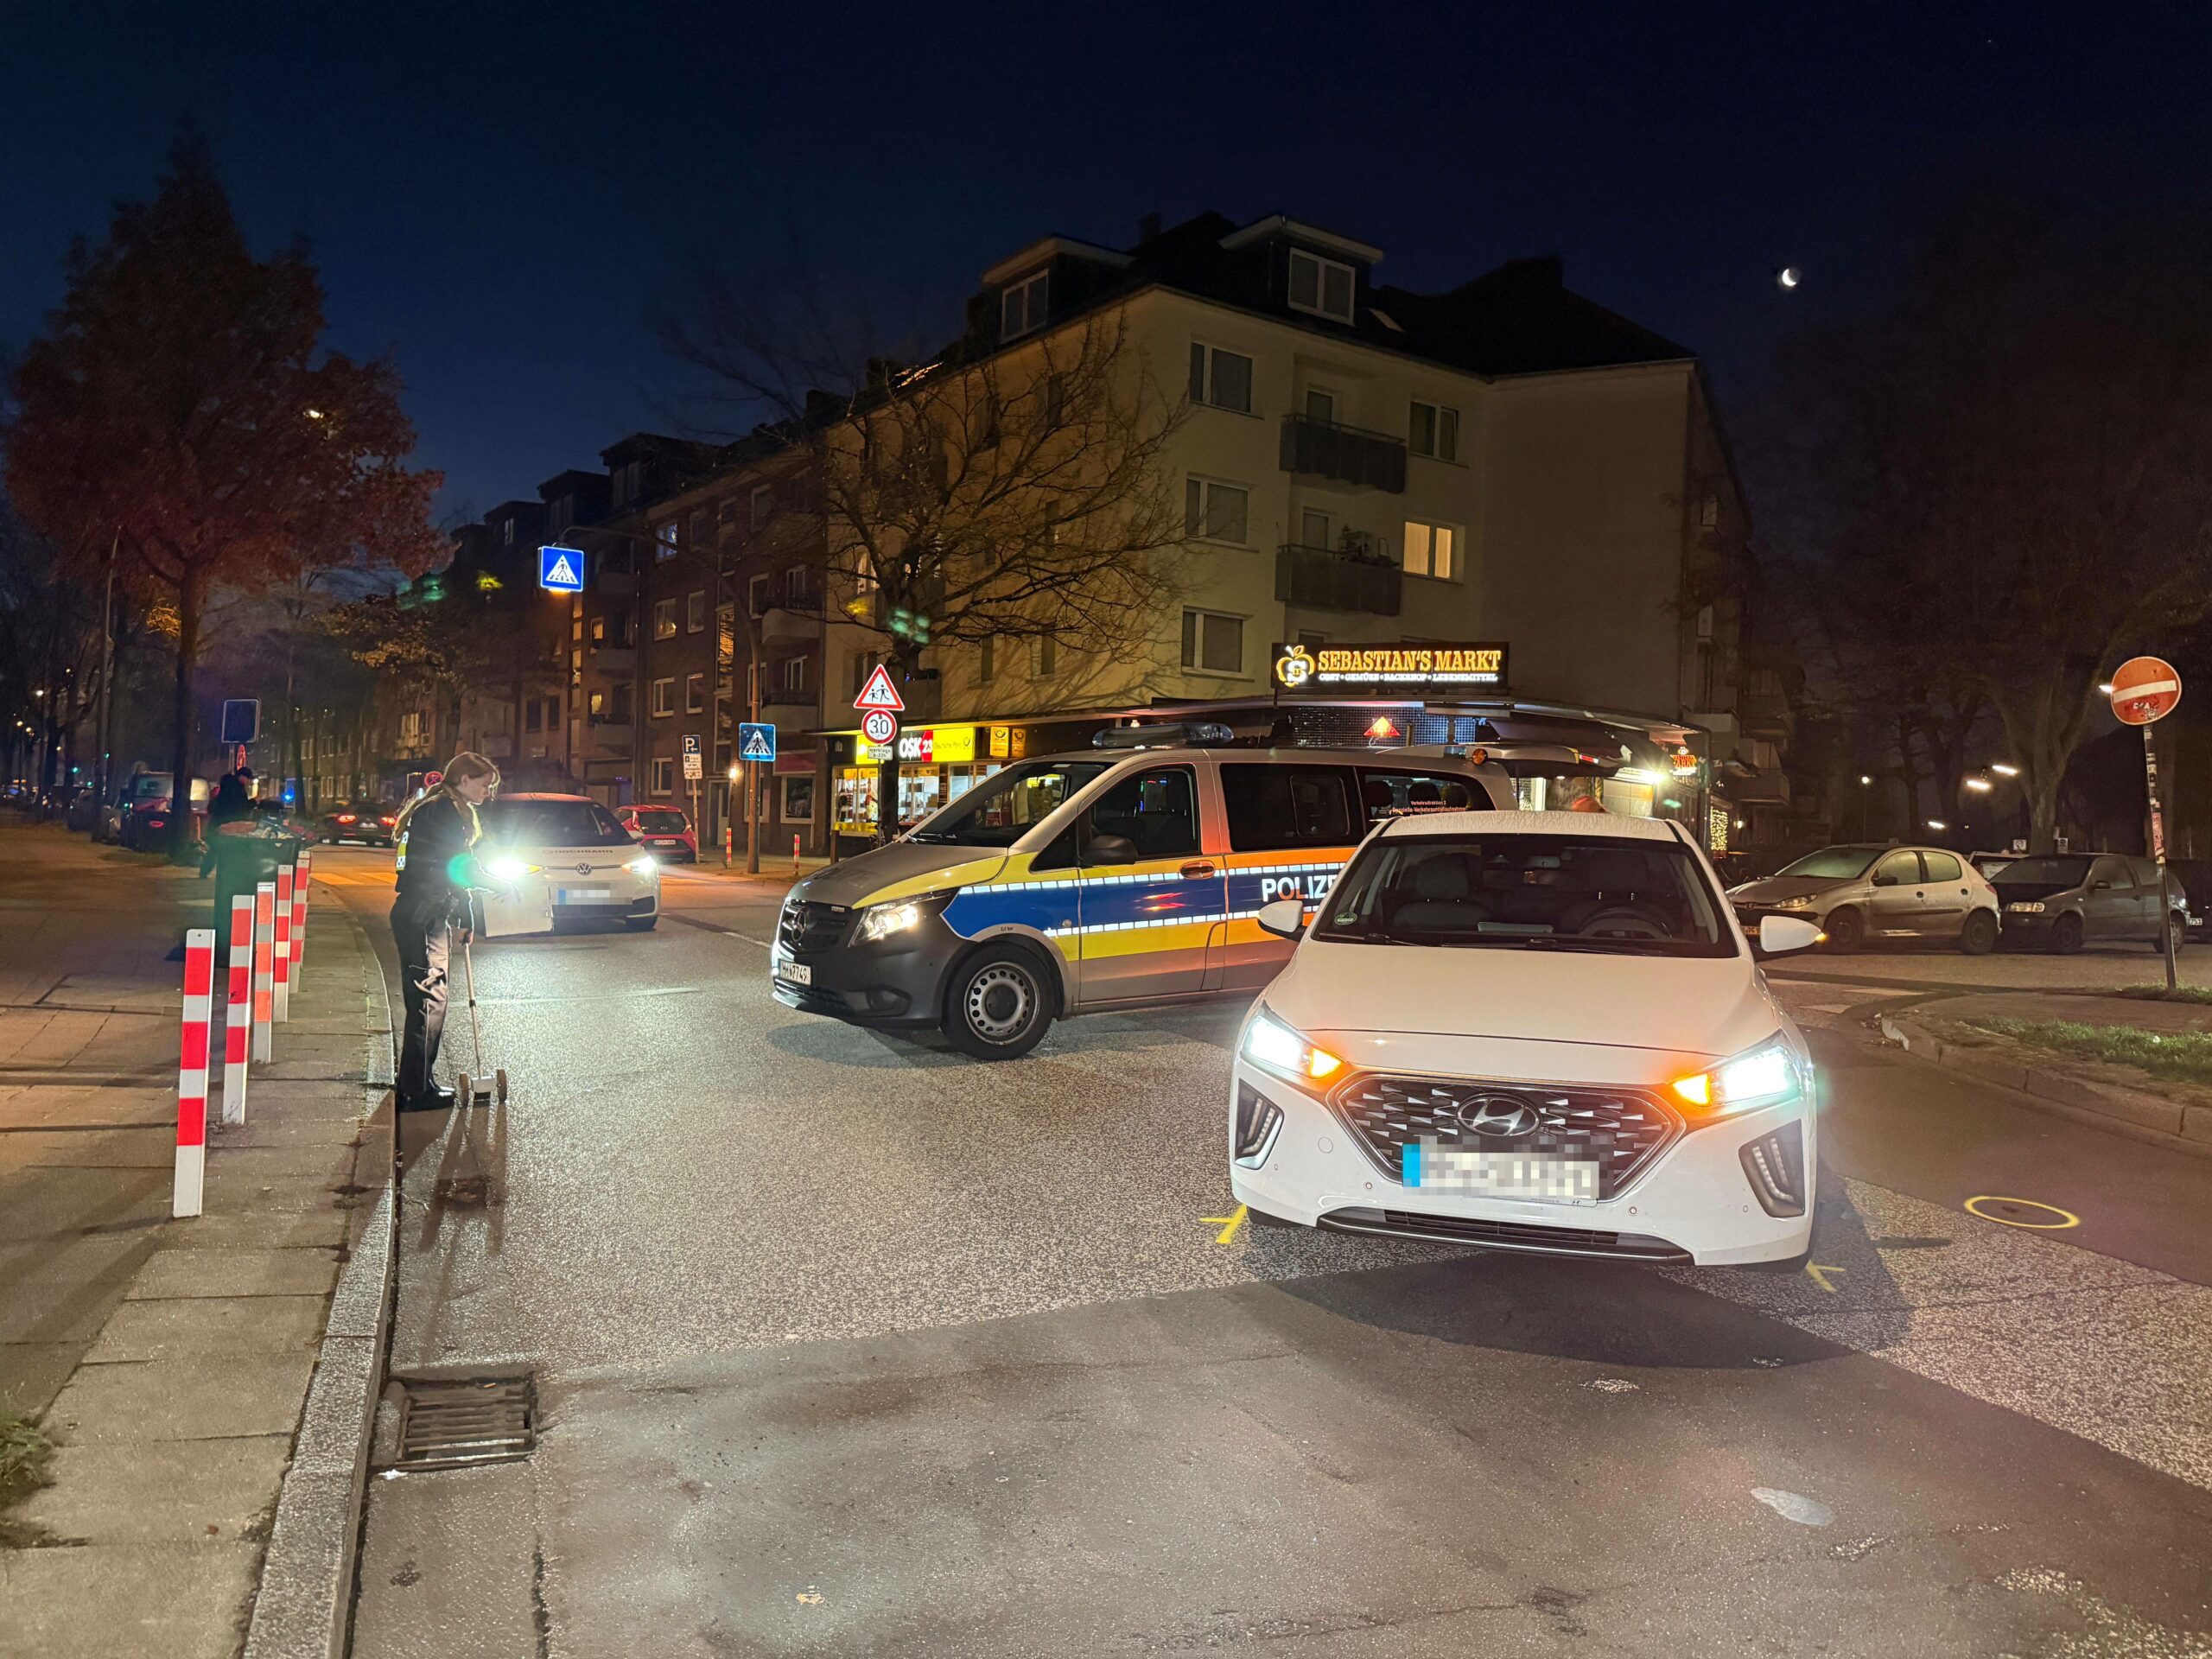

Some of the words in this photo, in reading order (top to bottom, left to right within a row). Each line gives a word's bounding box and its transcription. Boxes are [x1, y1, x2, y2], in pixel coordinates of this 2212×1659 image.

[1318, 650, 1431, 671] SEBASTIAN'S
[1433, 650, 1501, 671] MARKT
[870, 719, 889, 734] 30
[685, 738, 695, 753] P
[921, 739, 932, 753] 23
